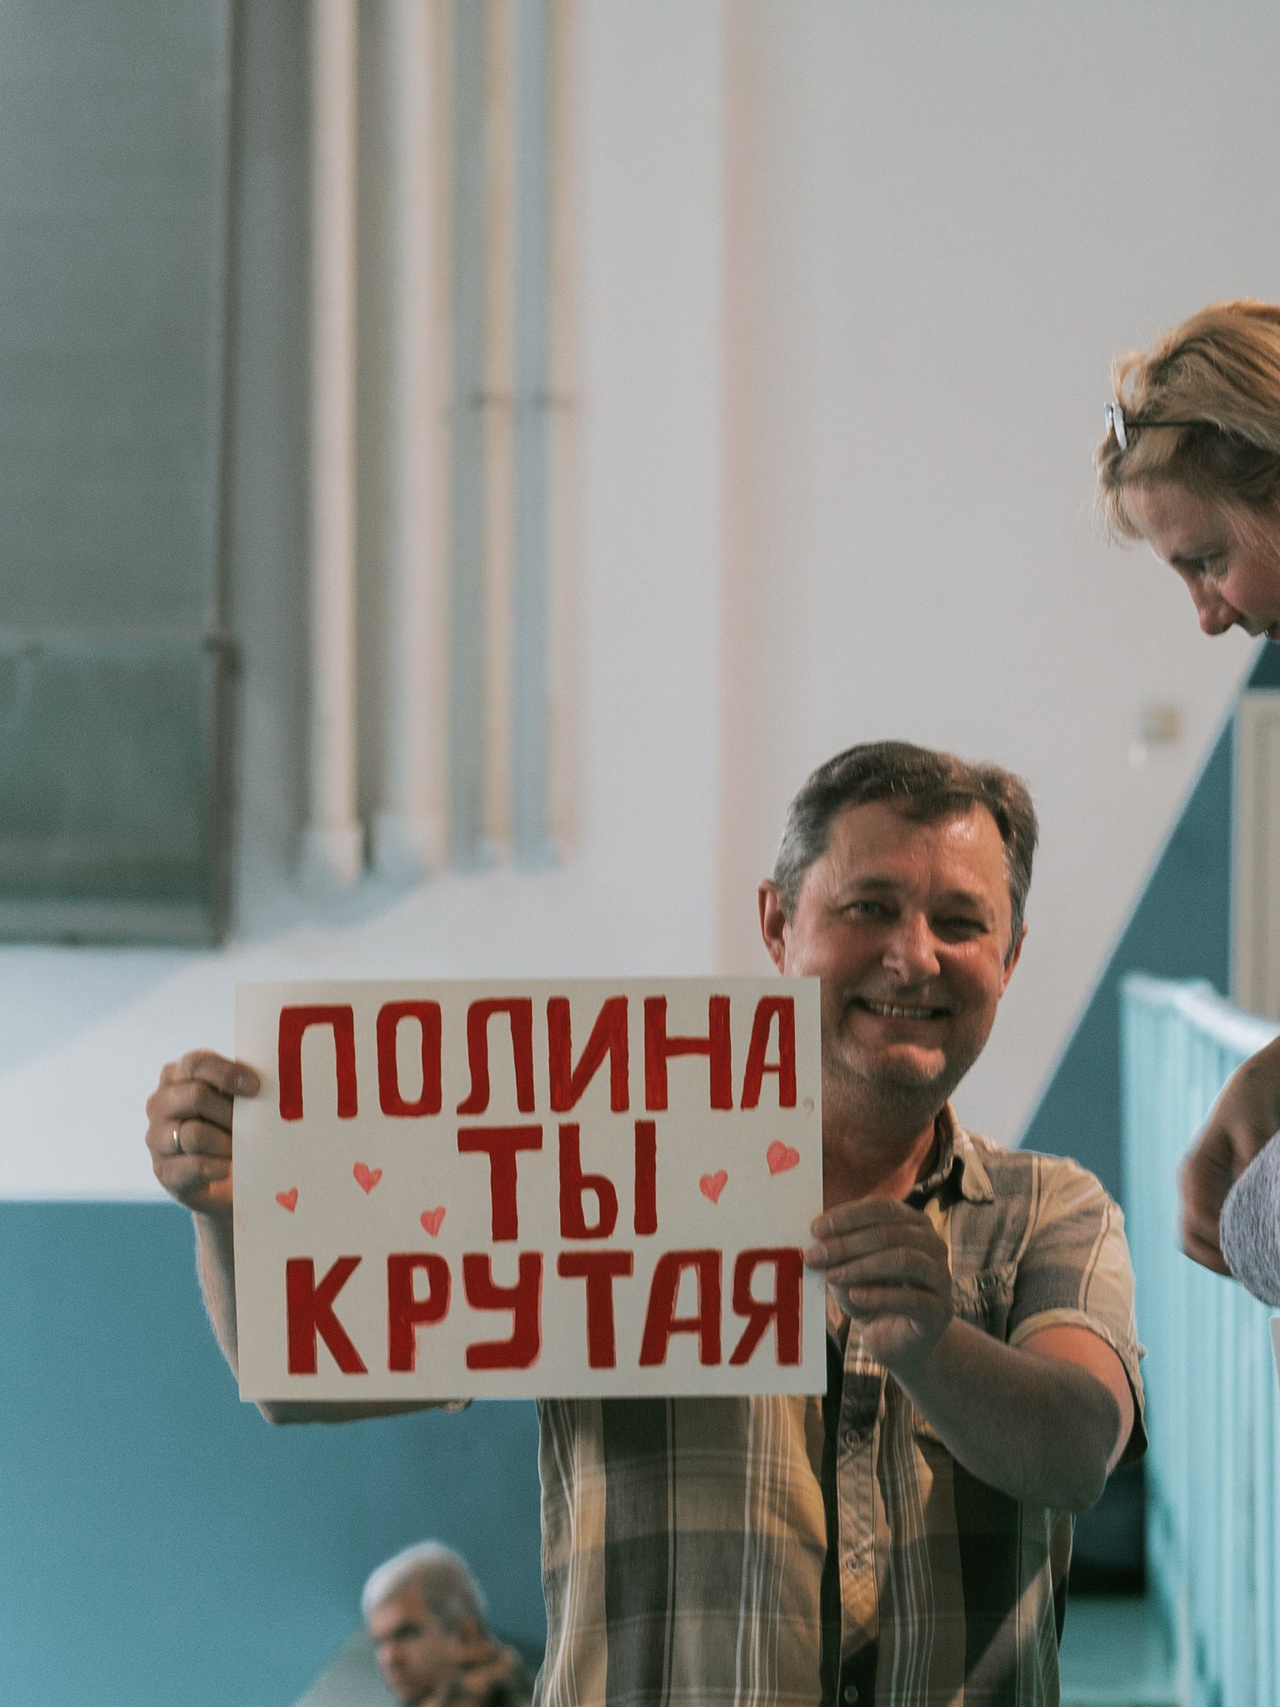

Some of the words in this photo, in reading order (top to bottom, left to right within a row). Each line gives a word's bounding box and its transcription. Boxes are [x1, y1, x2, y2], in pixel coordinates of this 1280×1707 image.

[277, 994, 799, 1122] ПОЛИНА
[456, 1120, 659, 1242] ТЫ
[284, 1246, 805, 1375] КРУТАЯ
